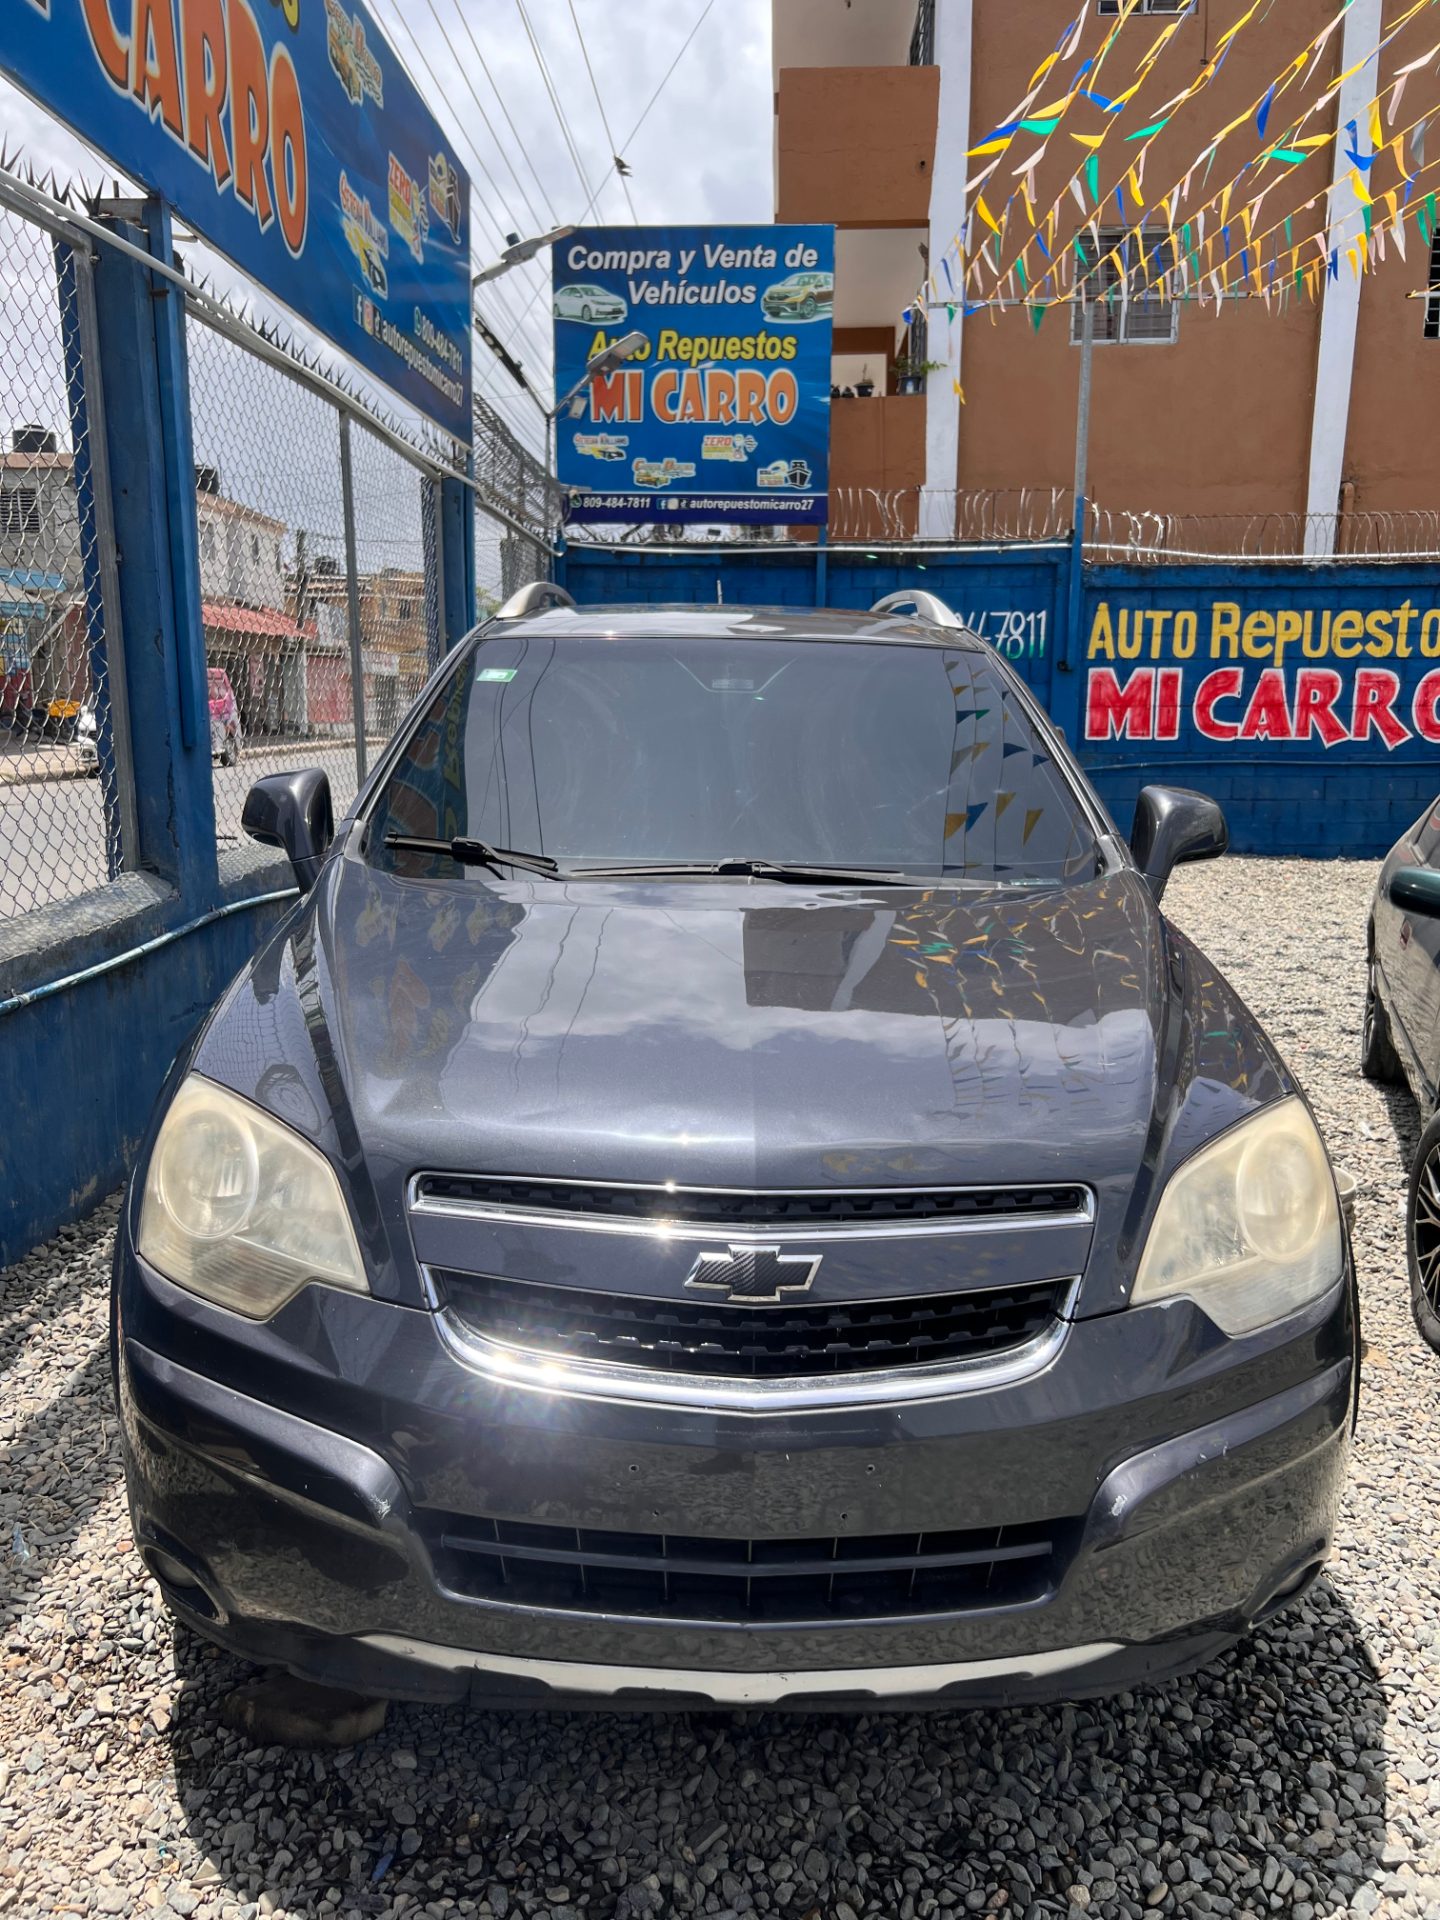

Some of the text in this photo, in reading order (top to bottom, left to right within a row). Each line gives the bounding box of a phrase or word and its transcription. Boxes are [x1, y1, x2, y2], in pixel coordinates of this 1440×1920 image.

[567, 242, 818, 275] Compra y Venta de
[627, 280, 756, 305] Vehículos
[657, 330, 797, 367] Repuestos
[590, 368, 798, 425] MI CARRO
[704, 437, 732, 447] ZERO
[583, 498, 814, 511] 809-484-7811 autorepuestomicarro27
[1087, 602, 1197, 660] AUTO
[1085, 667, 1440, 751] MI CARRO
